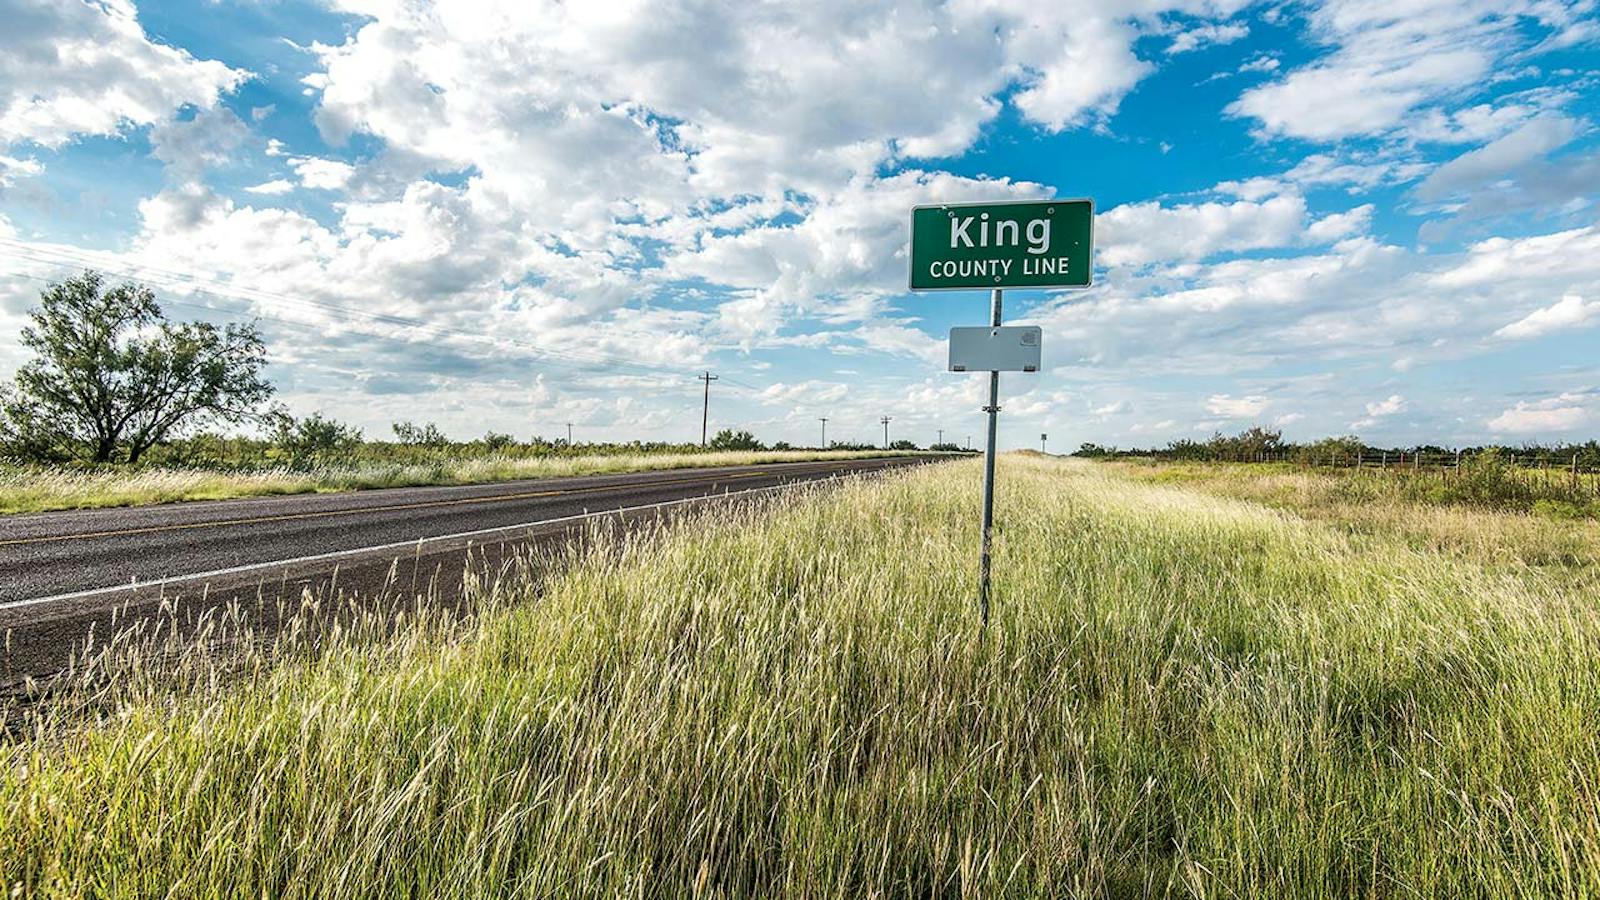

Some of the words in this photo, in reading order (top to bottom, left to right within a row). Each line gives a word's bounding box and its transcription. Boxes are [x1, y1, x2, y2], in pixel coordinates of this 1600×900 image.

[950, 213, 1050, 254] King
[930, 259, 1012, 277] COUNTY
[1023, 257, 1069, 275] LINE
